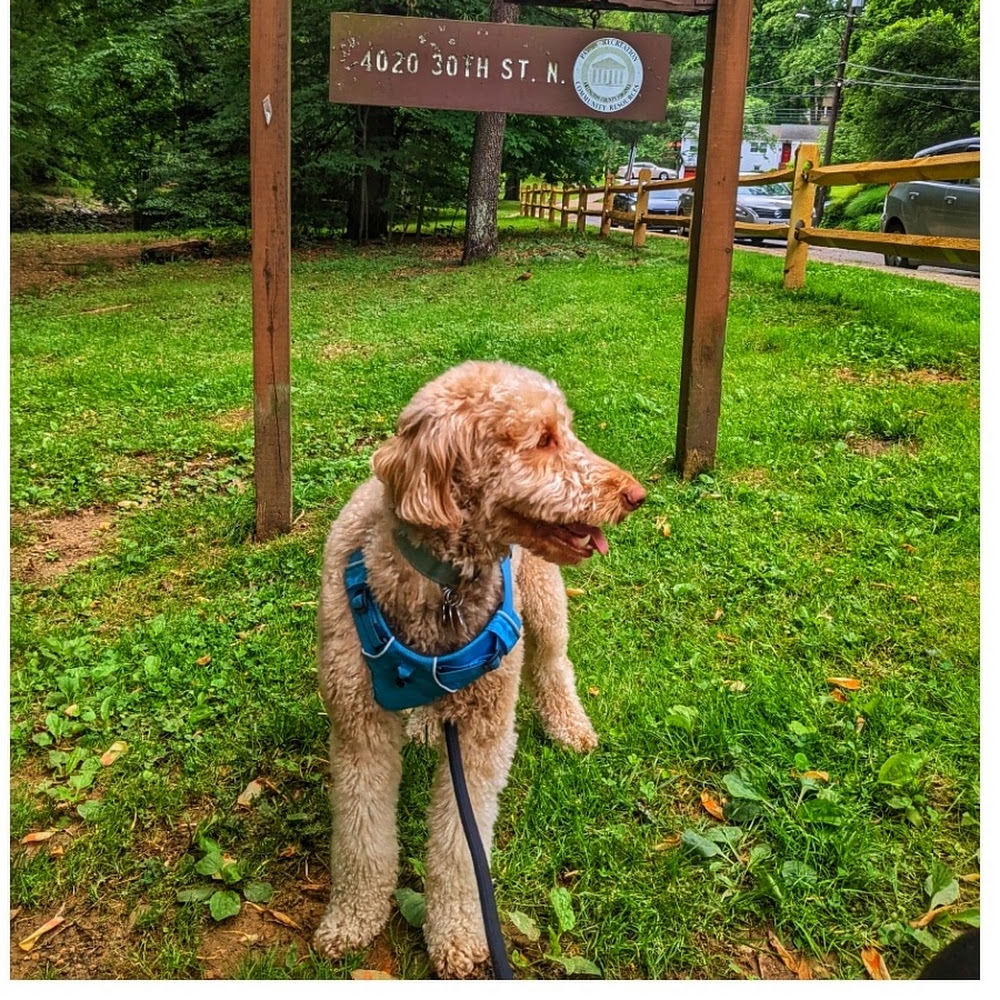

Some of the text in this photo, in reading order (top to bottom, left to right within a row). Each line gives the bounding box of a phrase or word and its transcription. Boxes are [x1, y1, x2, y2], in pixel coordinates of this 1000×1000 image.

[360, 50, 567, 85] 4020 30TH ST. N.
